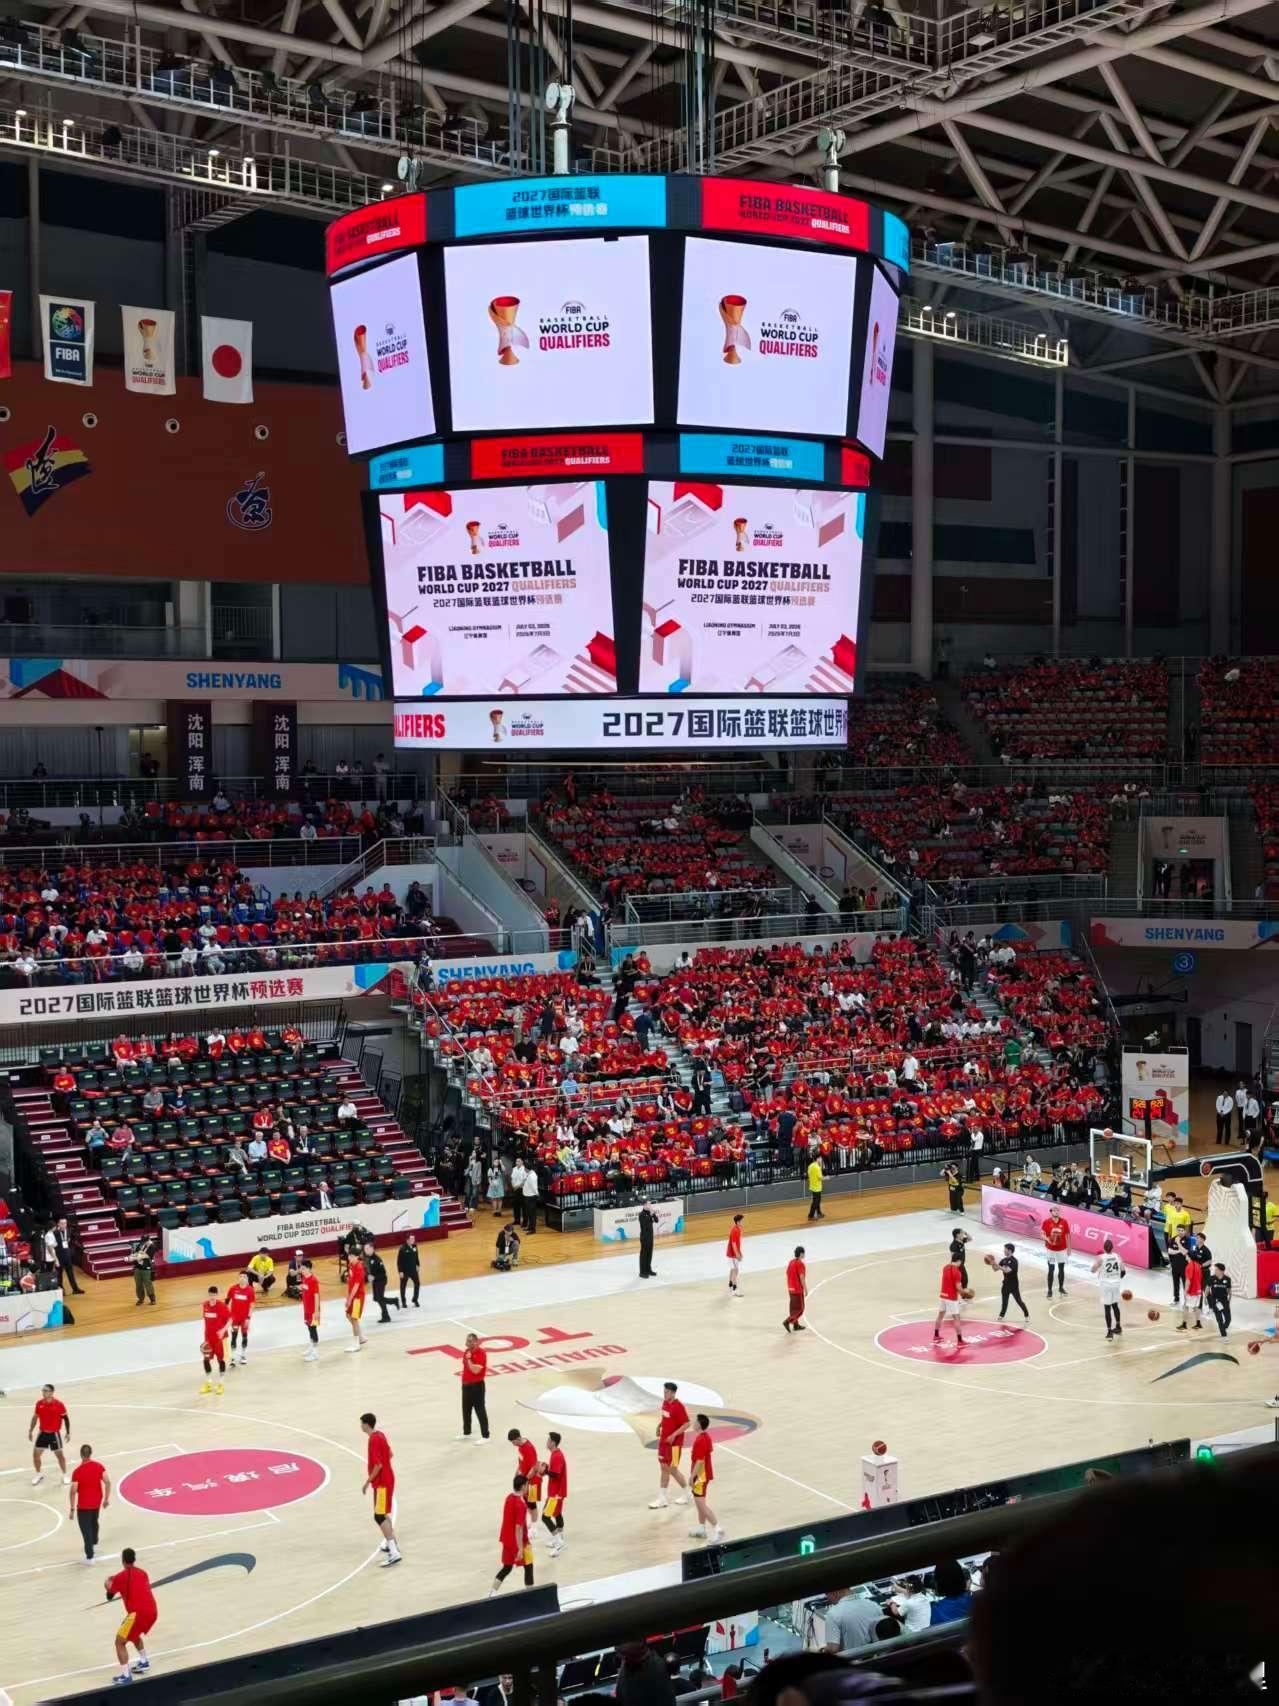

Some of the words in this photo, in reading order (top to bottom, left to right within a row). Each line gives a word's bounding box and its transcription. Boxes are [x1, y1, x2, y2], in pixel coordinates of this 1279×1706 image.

[512, 187, 600, 203] 2027国际篮联
[738, 194, 771, 209] FIBA
[775, 197, 849, 224] BASKETBALL
[811, 218, 851, 234] QUALIFIERS
[565, 305, 582, 314] FIBA
[540, 314, 609, 323] BASKETBALL
[539, 323, 582, 335] WORLD
[585, 321, 610, 332] CUP
[760, 328, 797, 341] WORLD
[798, 332, 819, 343] CUP
[376, 343, 396, 357] WORLD
[396, 338, 408, 351] CUP
[539, 333, 611, 351] QUALIFIERS
[759, 340, 818, 358] QUALIFIERS
[55, 347, 80, 362] FIBA
[377, 350, 409, 373] QUALIFIERS
[564, 456, 611, 466] QUALIFIERS
[417, 565, 458, 582] FIBA
[461, 559, 577, 580] BASKETBALL
[678, 559, 719, 576] FIBA
[723, 560, 831, 580] BASKETBALL
[418, 584, 454, 595] WORLD
[457, 582, 480, 593] CUP
[482, 581, 510, 592] 2027
[511, 578, 577, 592] QUALIFIERS
[677, 578, 714, 590] WORLD
[716, 579, 739, 590] CUP
[741, 580, 769, 591] 2027
[770, 580, 830, 593] QUALIFIERS
[186, 672, 282, 689] SHENYANG
[1144, 927, 1225, 941] SHENYANG
[20, 977, 304, 1015] 2027国际篮联篮球世界杯预选赛
[277, 1223, 294, 1231] FIBA
[295, 1216, 341, 1229] BASKETBALL
[257, 1233, 283, 1242] WORLD
[284, 1231, 300, 1239] CUP
[301, 1228, 319, 1238] 2027
[1105, 1261, 1120, 1273] 24
